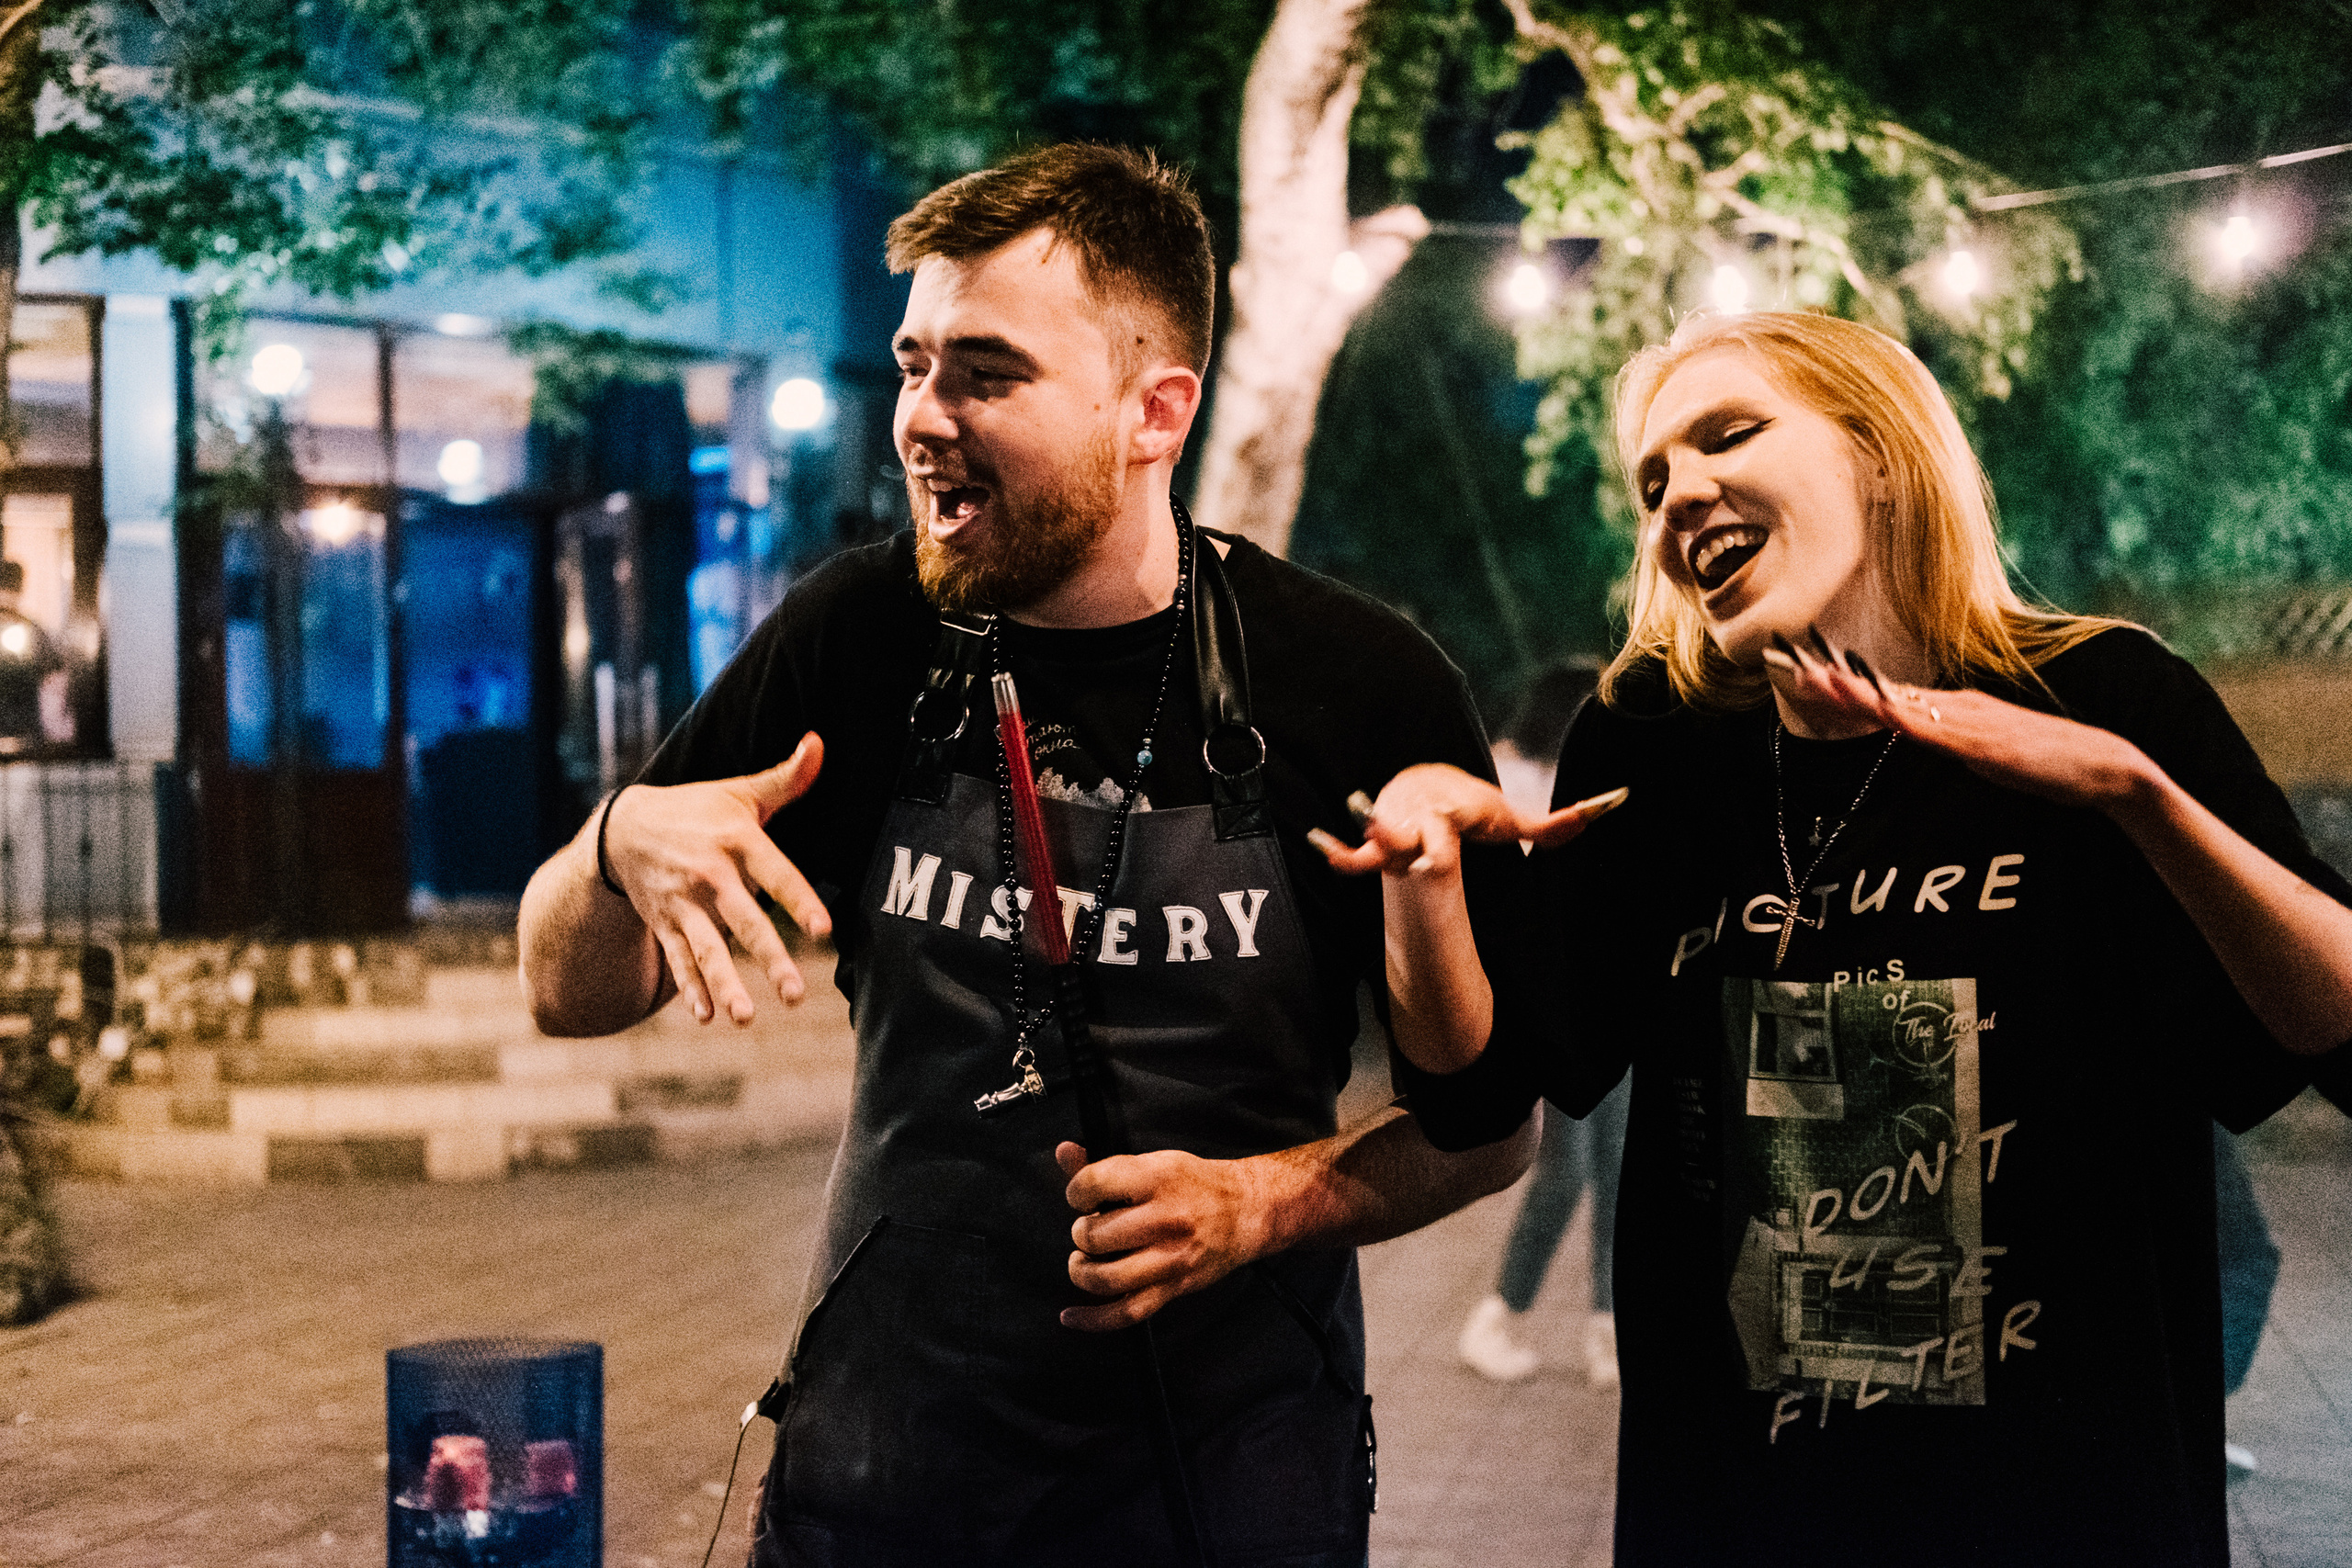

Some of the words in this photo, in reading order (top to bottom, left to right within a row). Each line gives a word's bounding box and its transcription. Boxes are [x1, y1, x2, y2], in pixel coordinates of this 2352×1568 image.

[879, 846, 1269, 965] MISTERY
[1670, 853, 2025, 976] PICTURE
[1829, 1244, 2008, 1298] USE
[1770, 1301, 2041, 1445] FILTER
